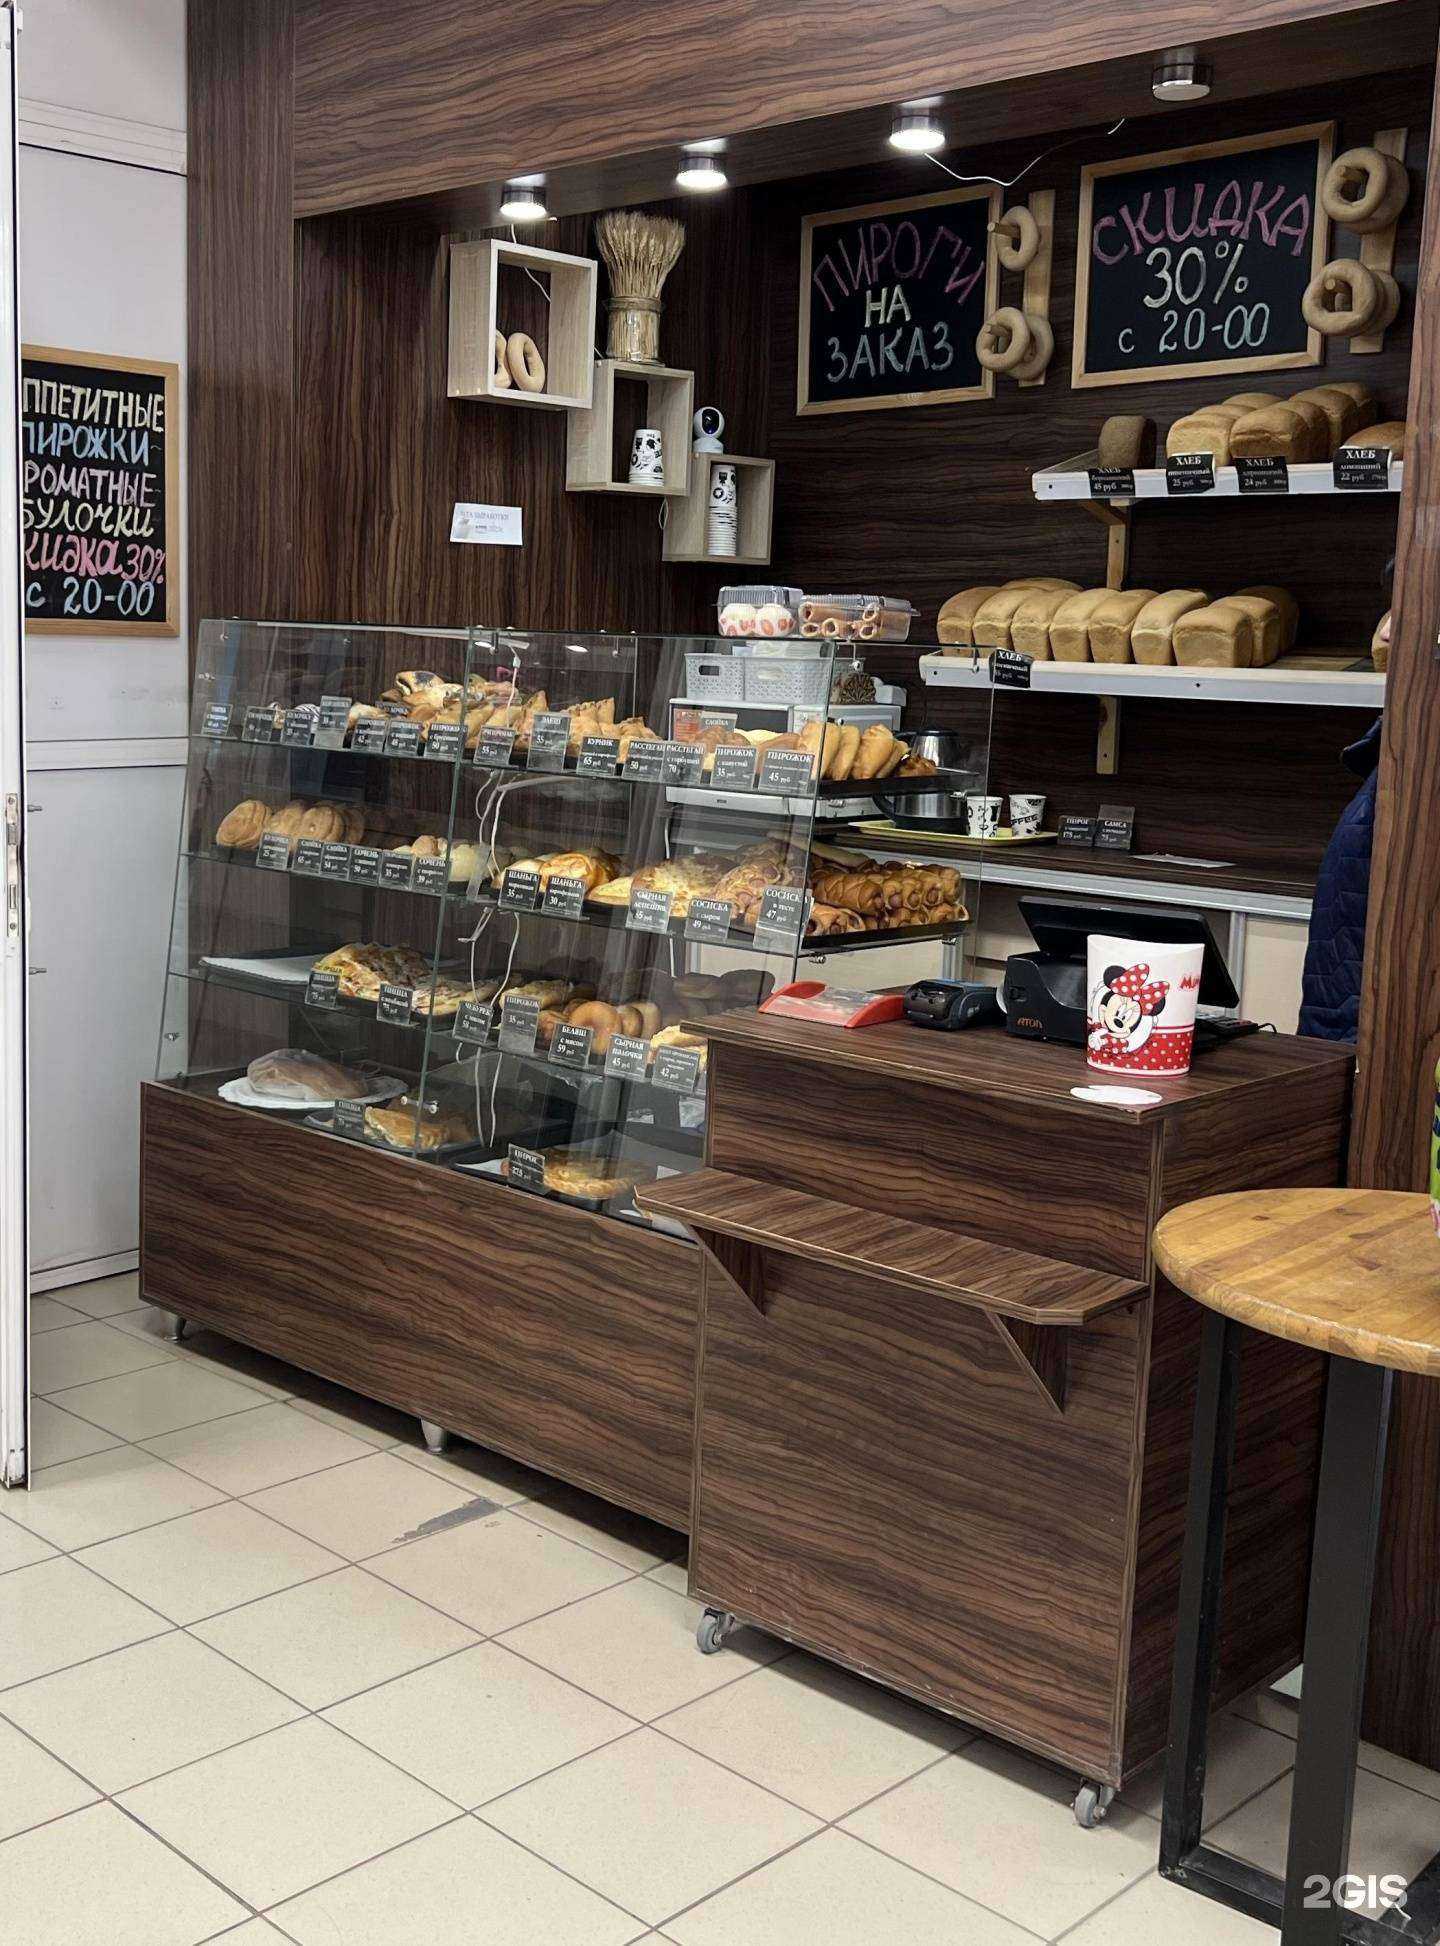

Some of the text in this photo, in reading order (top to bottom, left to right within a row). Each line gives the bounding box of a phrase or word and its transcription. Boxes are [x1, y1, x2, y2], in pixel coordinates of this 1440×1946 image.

[1093, 180, 1310, 265] СКИДКА
[813, 221, 985, 311] ПИРОГИ
[1143, 241, 1249, 308] 30%
[865, 284, 911, 327] НА
[1159, 303, 1270, 353] 20-00
[827, 322, 954, 383] ЗАКАЗ
[22, 421, 148, 466] ПИРОЖКИ
[1346, 450, 1376, 459] ХЛЕБ
[1176, 457, 1201, 466] ХЛЕБ
[1246, 459, 1274, 467] ХЛЕБ
[1352, 473, 1365, 482] руб
[1103, 483, 1117, 492] руб
[1183, 480, 1194, 489] руб
[122, 544, 165, 584] 30%
[64, 577, 155, 615] 20-00
[999, 651, 1022, 661] ХЛЕБ
[716, 748, 753, 758] ПИРОЖОК
[767, 751, 813, 763] ПИРОЖОК
[583, 756, 592, 765] 65
[768, 772, 779, 782] 45
[508, 871, 538, 882] ШАНЬГА
[551, 876, 582, 889] ШАНЬГА
[549, 896, 558, 905] 30
[691, 899, 728, 912] СОСИСКА
[766, 909, 776, 919] 47
[556, 1043, 566, 1054] 59
[614, 1038, 645, 1050] СЫРНАЯ
[612, 1057, 621, 1067] 45
